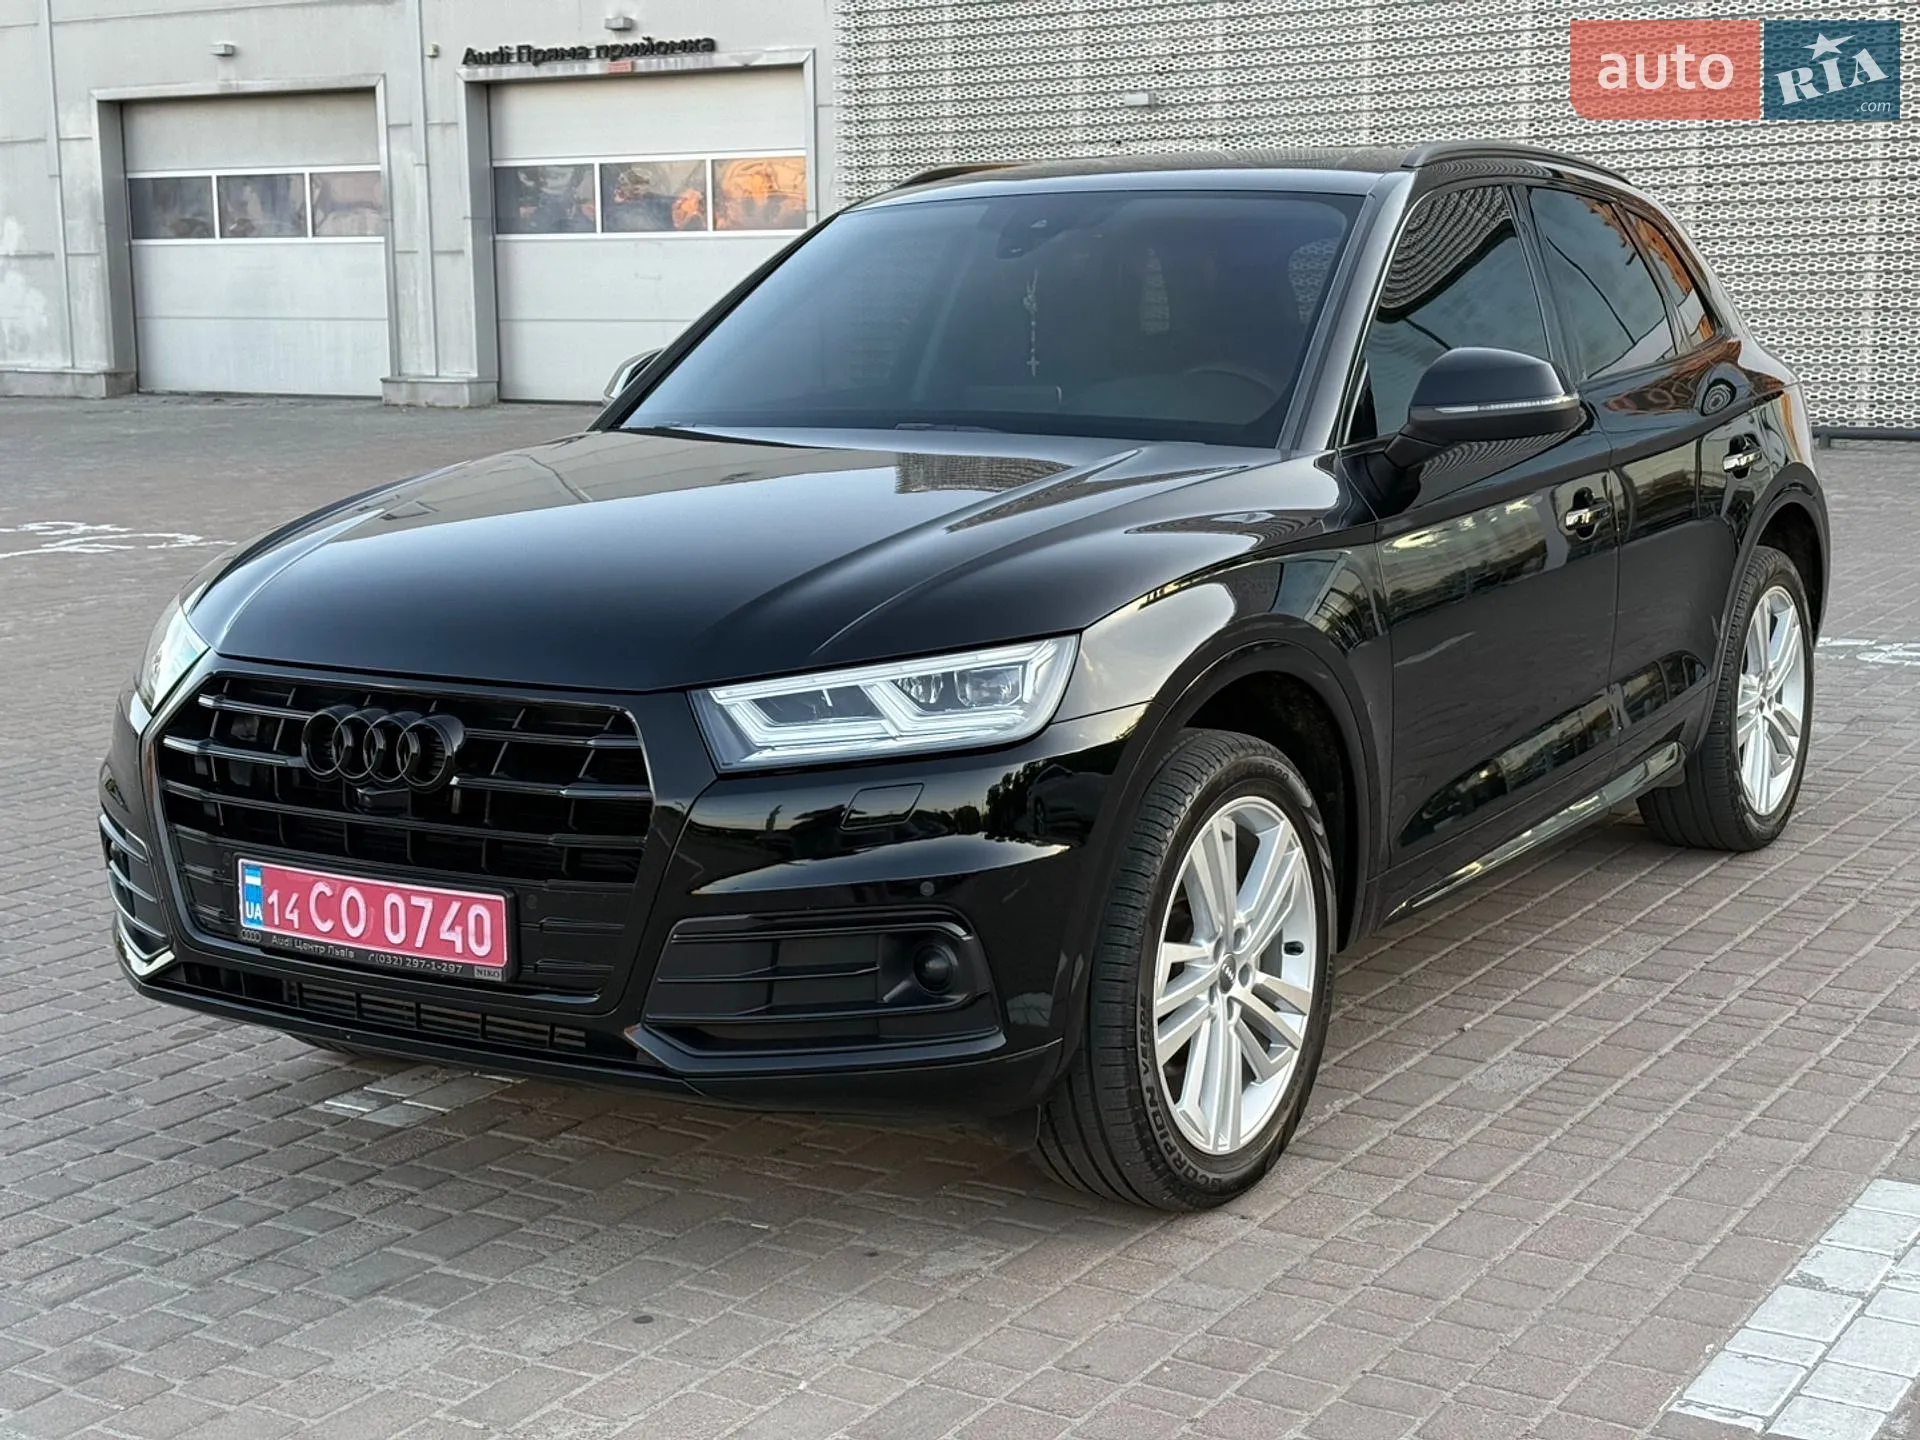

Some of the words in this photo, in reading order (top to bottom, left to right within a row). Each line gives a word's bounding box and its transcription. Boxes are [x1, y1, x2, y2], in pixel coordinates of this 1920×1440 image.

[461, 46, 510, 65] Audi
[516, 44, 589, 66] Пряма
[596, 36, 717, 62] прийомка
[245, 901, 263, 922] UA
[383, 892, 491, 957] 0740
[271, 935, 293, 947] Audi
[295, 939, 326, 954] Центр
[375, 953, 402, 966] (032)
[406, 958, 463, 973] 297-1-297
